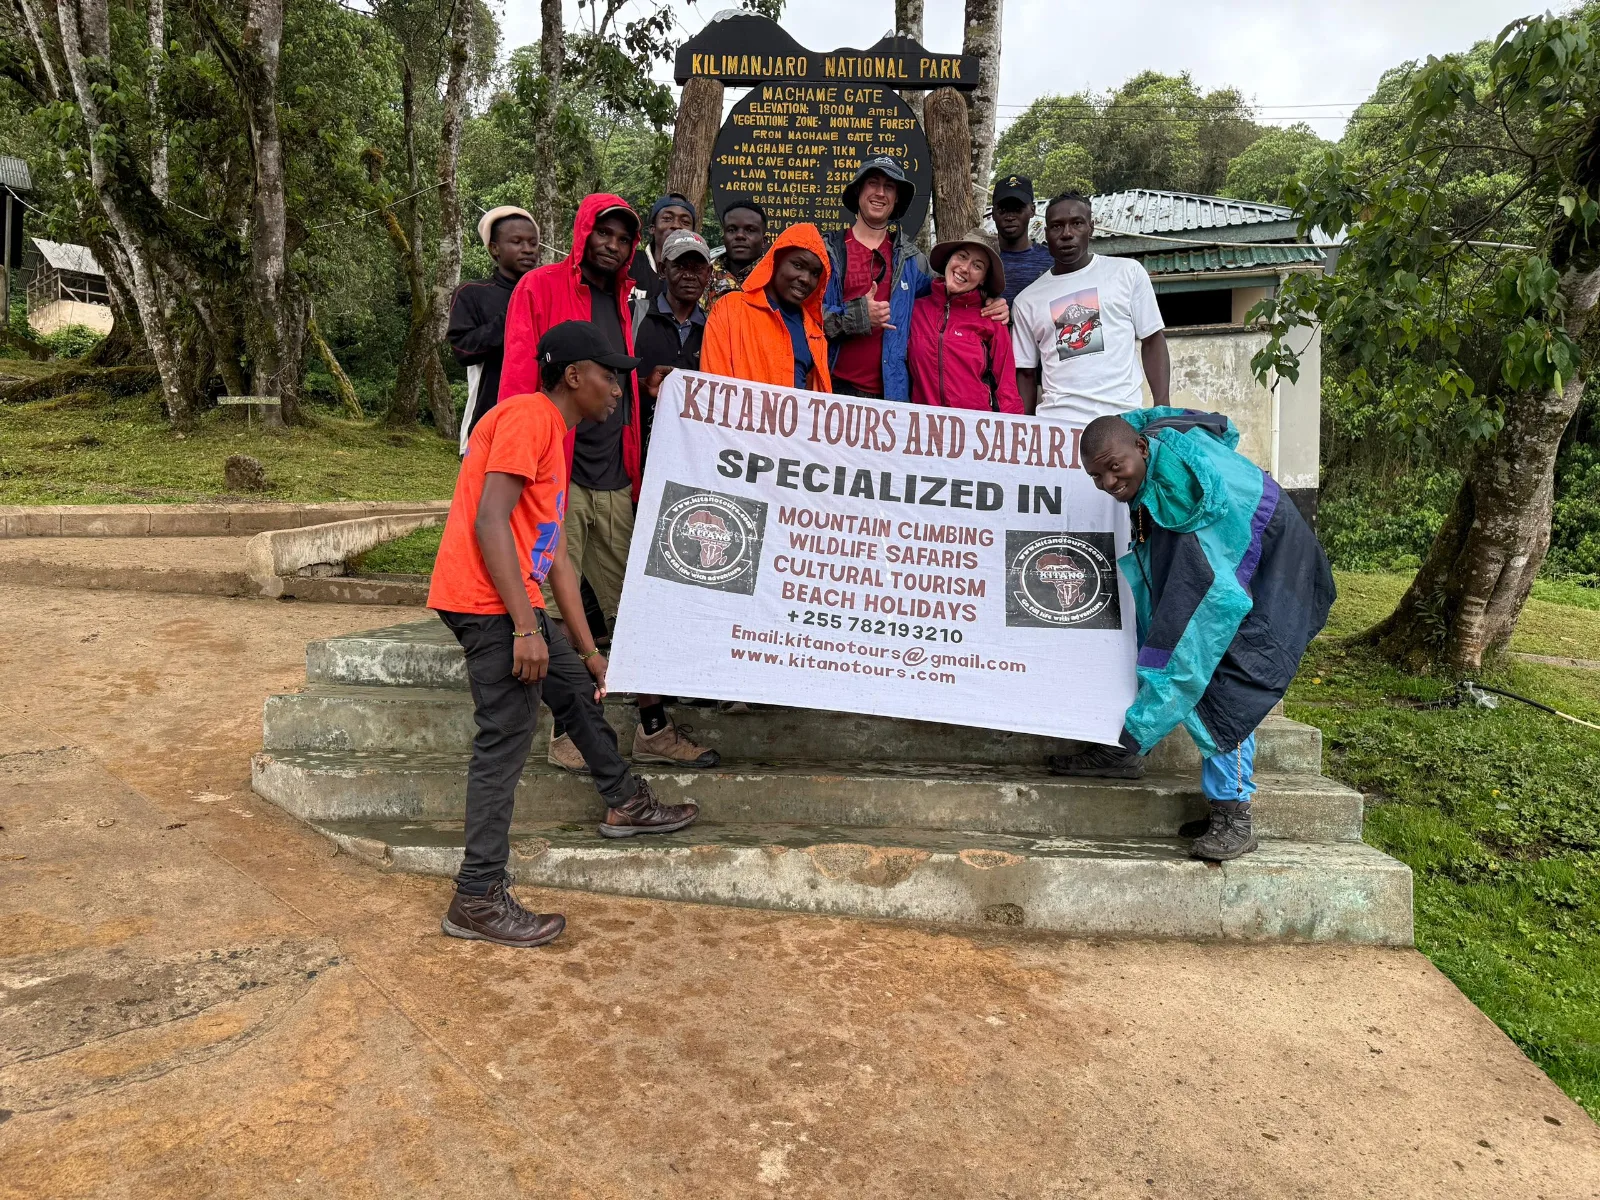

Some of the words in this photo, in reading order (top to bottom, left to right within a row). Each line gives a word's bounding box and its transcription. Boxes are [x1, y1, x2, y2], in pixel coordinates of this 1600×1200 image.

[692, 53, 807, 77] KILIMANJARO
[825, 56, 908, 78] NATIONAL
[920, 58, 962, 79] PARK
[762, 86, 838, 102] MACHAME
[844, 88, 883, 103] GATE
[749, 102, 809, 114] ELEVATION:
[819, 103, 854, 116] 1800M
[868, 106, 898, 117] amsl
[733, 113, 789, 126] VEGETATIONE
[830, 116, 873, 129] MONTANE
[880, 118, 916, 130] FOREST
[752, 129, 782, 139] FROM
[788, 130, 839, 140] MACHAME
[847, 132, 873, 141] GATE
[878, 133, 896, 142] TO:
[832, 145, 856, 156] 11KM
[720, 155, 753, 166] SHIRA
[757, 156, 784, 167] CAVE
[788, 158, 820, 168] CAMP:
[741, 168, 767, 179] LAVA
[725, 181, 763, 192] ARRON
[766, 182, 821, 194] GLACIER:
[814, 209, 840, 219] 31KM
[680, 375, 799, 438] KITANO
[807, 397, 897, 453] TOURS
[902, 411, 966, 459] AND
[973, 418, 1084, 470] SAFARI
[717, 448, 1004, 511] SPECIALIZED
[1017, 484, 1062, 515] IN
[778, 505, 892, 538] MOUNTAIN
[897, 521, 994, 547] CLIMBING
[789, 531, 878, 561] WILDLIFE
[885, 544, 979, 570] SAFARIS
[1018, 537, 1104, 562] www.kitanotours.com
[773, 554, 884, 588] CULTURAL
[890, 570, 986, 598] TOURISM
[1040, 571, 1085, 580] KITANO
[781, 580, 856, 610] BEACH
[864, 593, 978, 622] HOLIDAYS
[1070, 600, 1103, 621] adventure
[848, 616, 963, 643] 782193210
